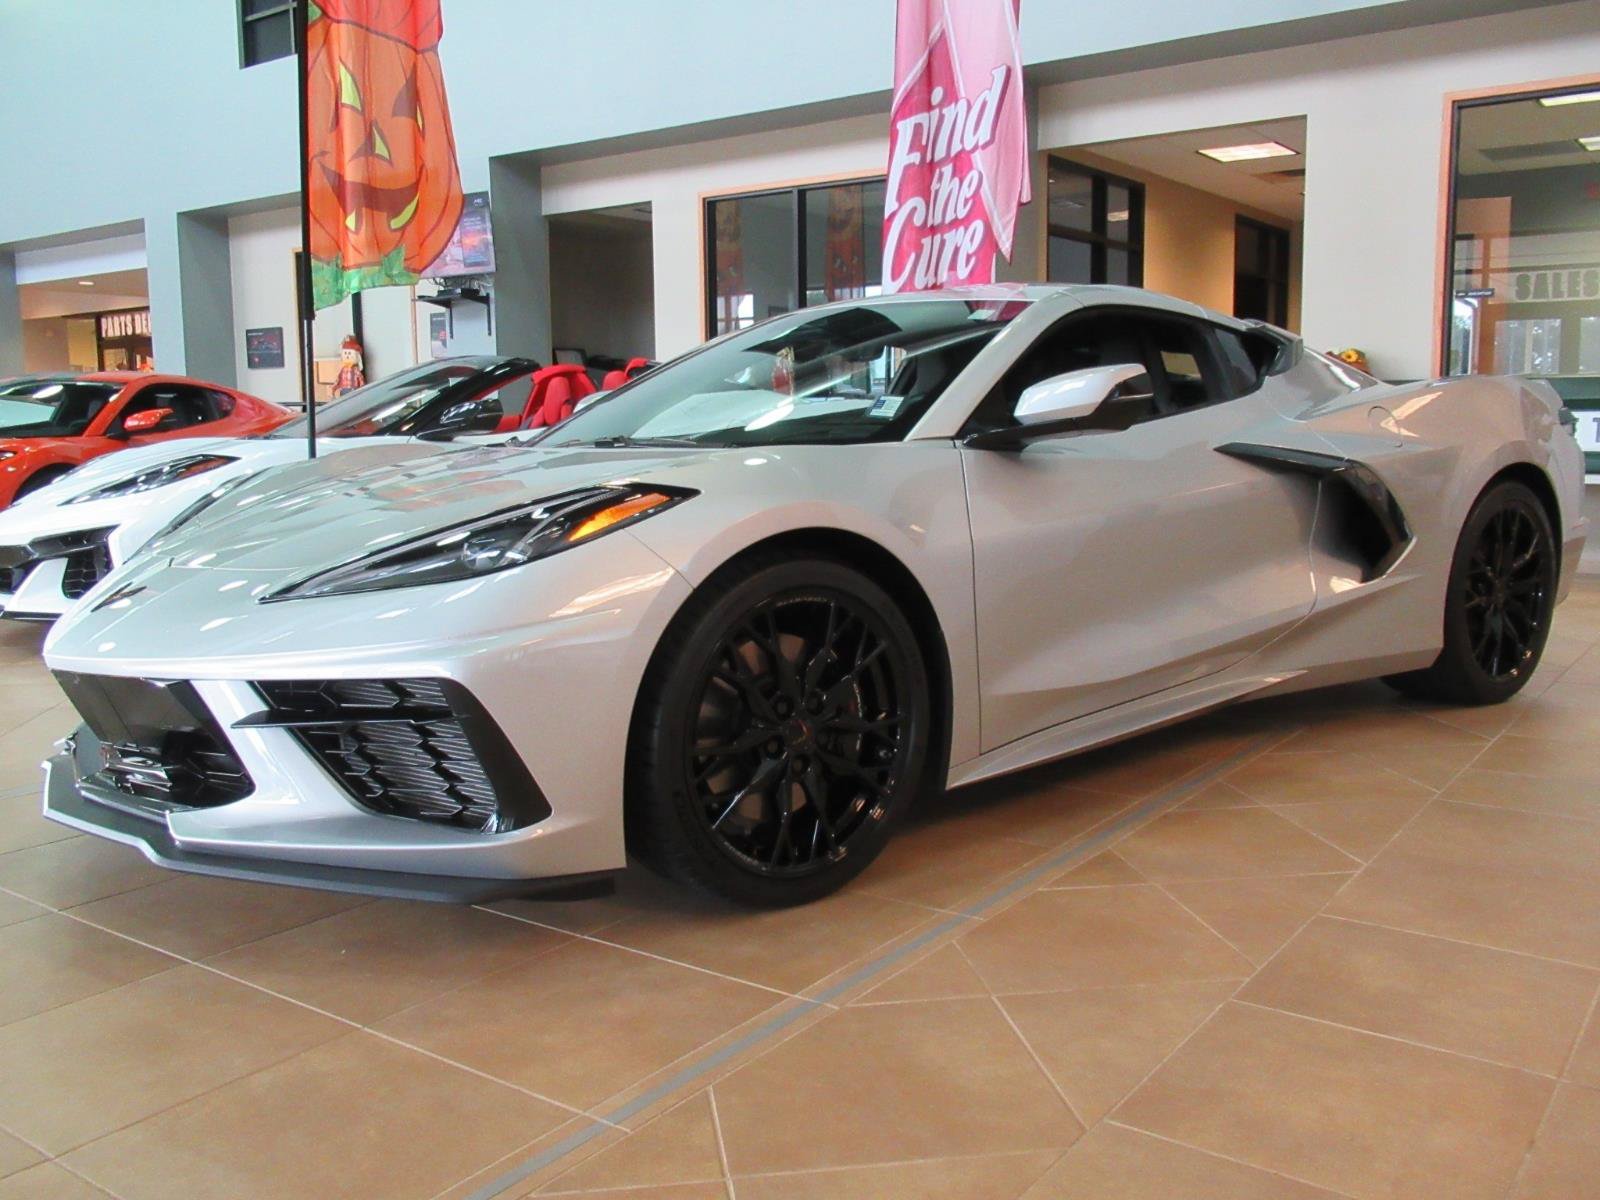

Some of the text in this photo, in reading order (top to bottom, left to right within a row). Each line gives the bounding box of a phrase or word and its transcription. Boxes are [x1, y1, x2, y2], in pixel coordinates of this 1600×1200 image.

[885, 64, 1009, 219] Find
[927, 162, 982, 227] the
[881, 196, 985, 294] Cure
[1515, 269, 1600, 301] SALES
[100, 313, 133, 338] PARTS
